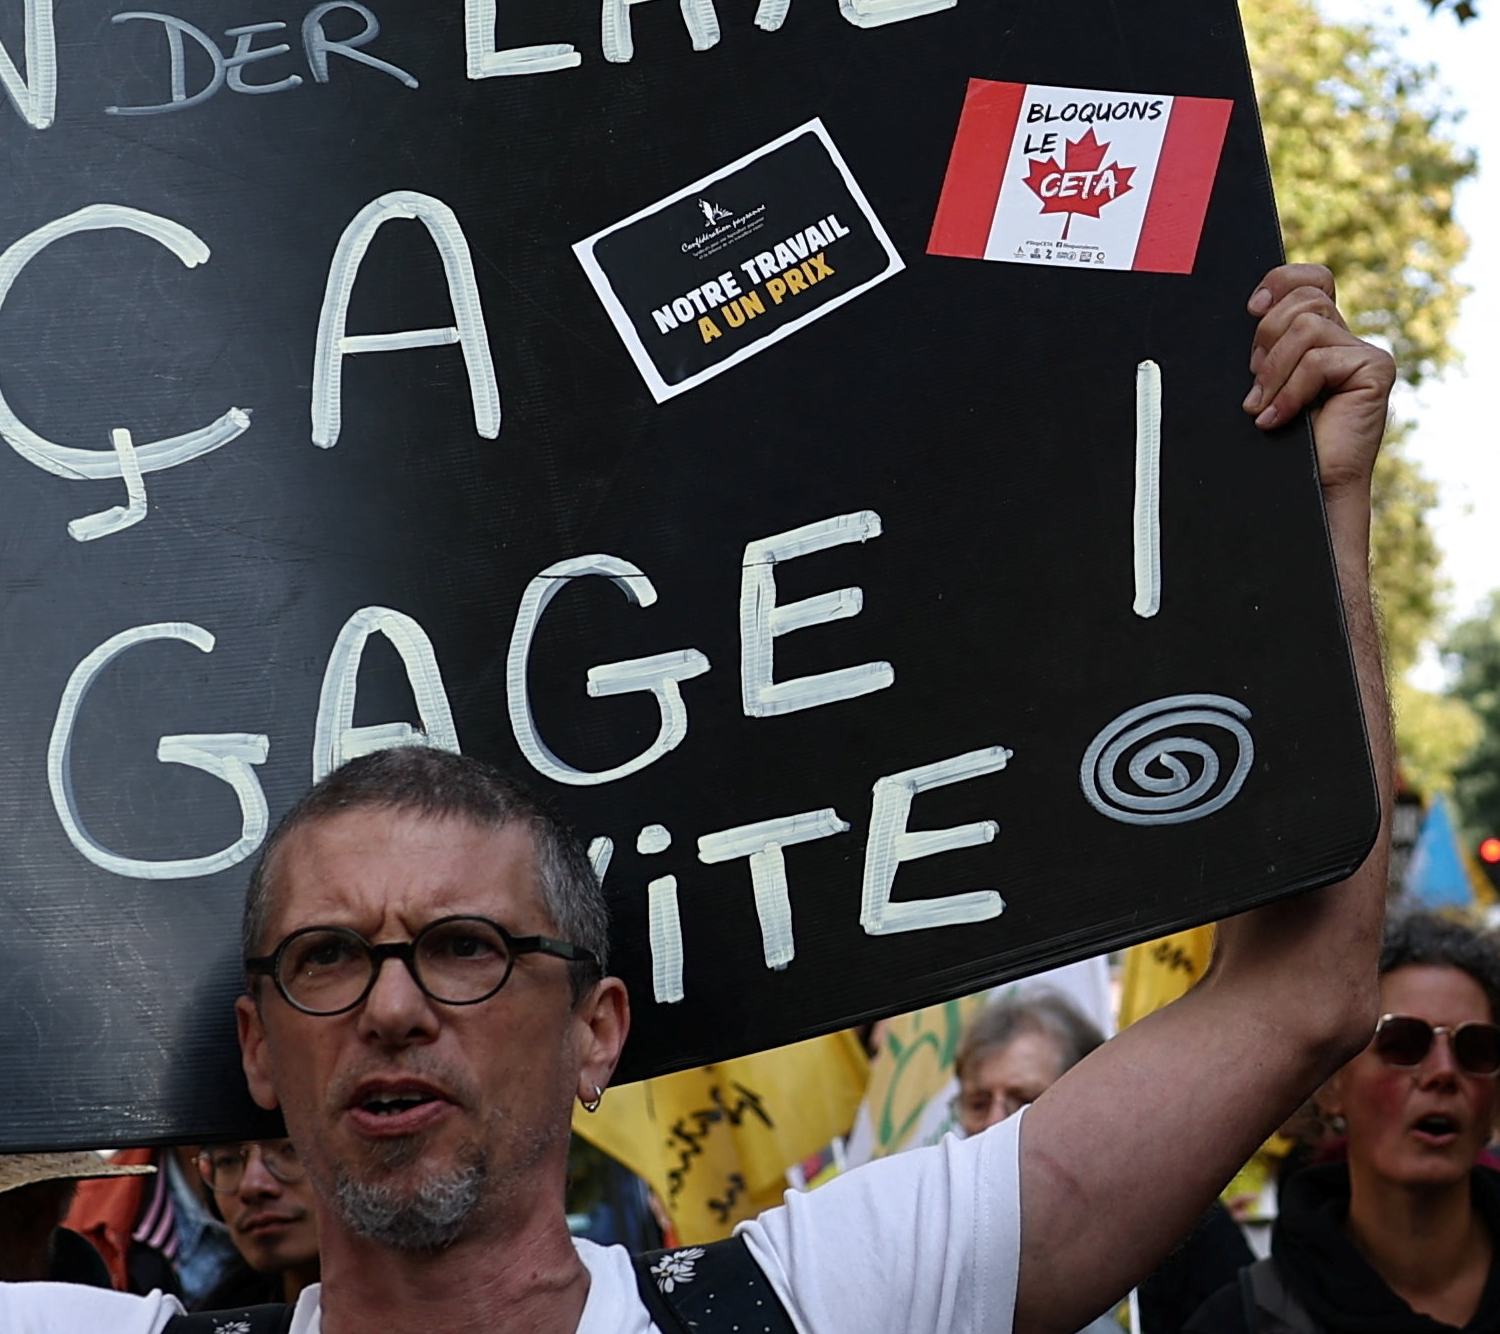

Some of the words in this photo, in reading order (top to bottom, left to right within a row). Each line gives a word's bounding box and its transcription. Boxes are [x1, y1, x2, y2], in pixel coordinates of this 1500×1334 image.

[1026, 100, 1164, 125] BLOQUONS
[1023, 132, 1060, 156] LE
[651, 271, 743, 335] NOTRE
[739, 214, 850, 285] TRAVAIL
[697, 316, 723, 345] A
[721, 290, 767, 328] UN
[765, 252, 836, 305] PRIX
